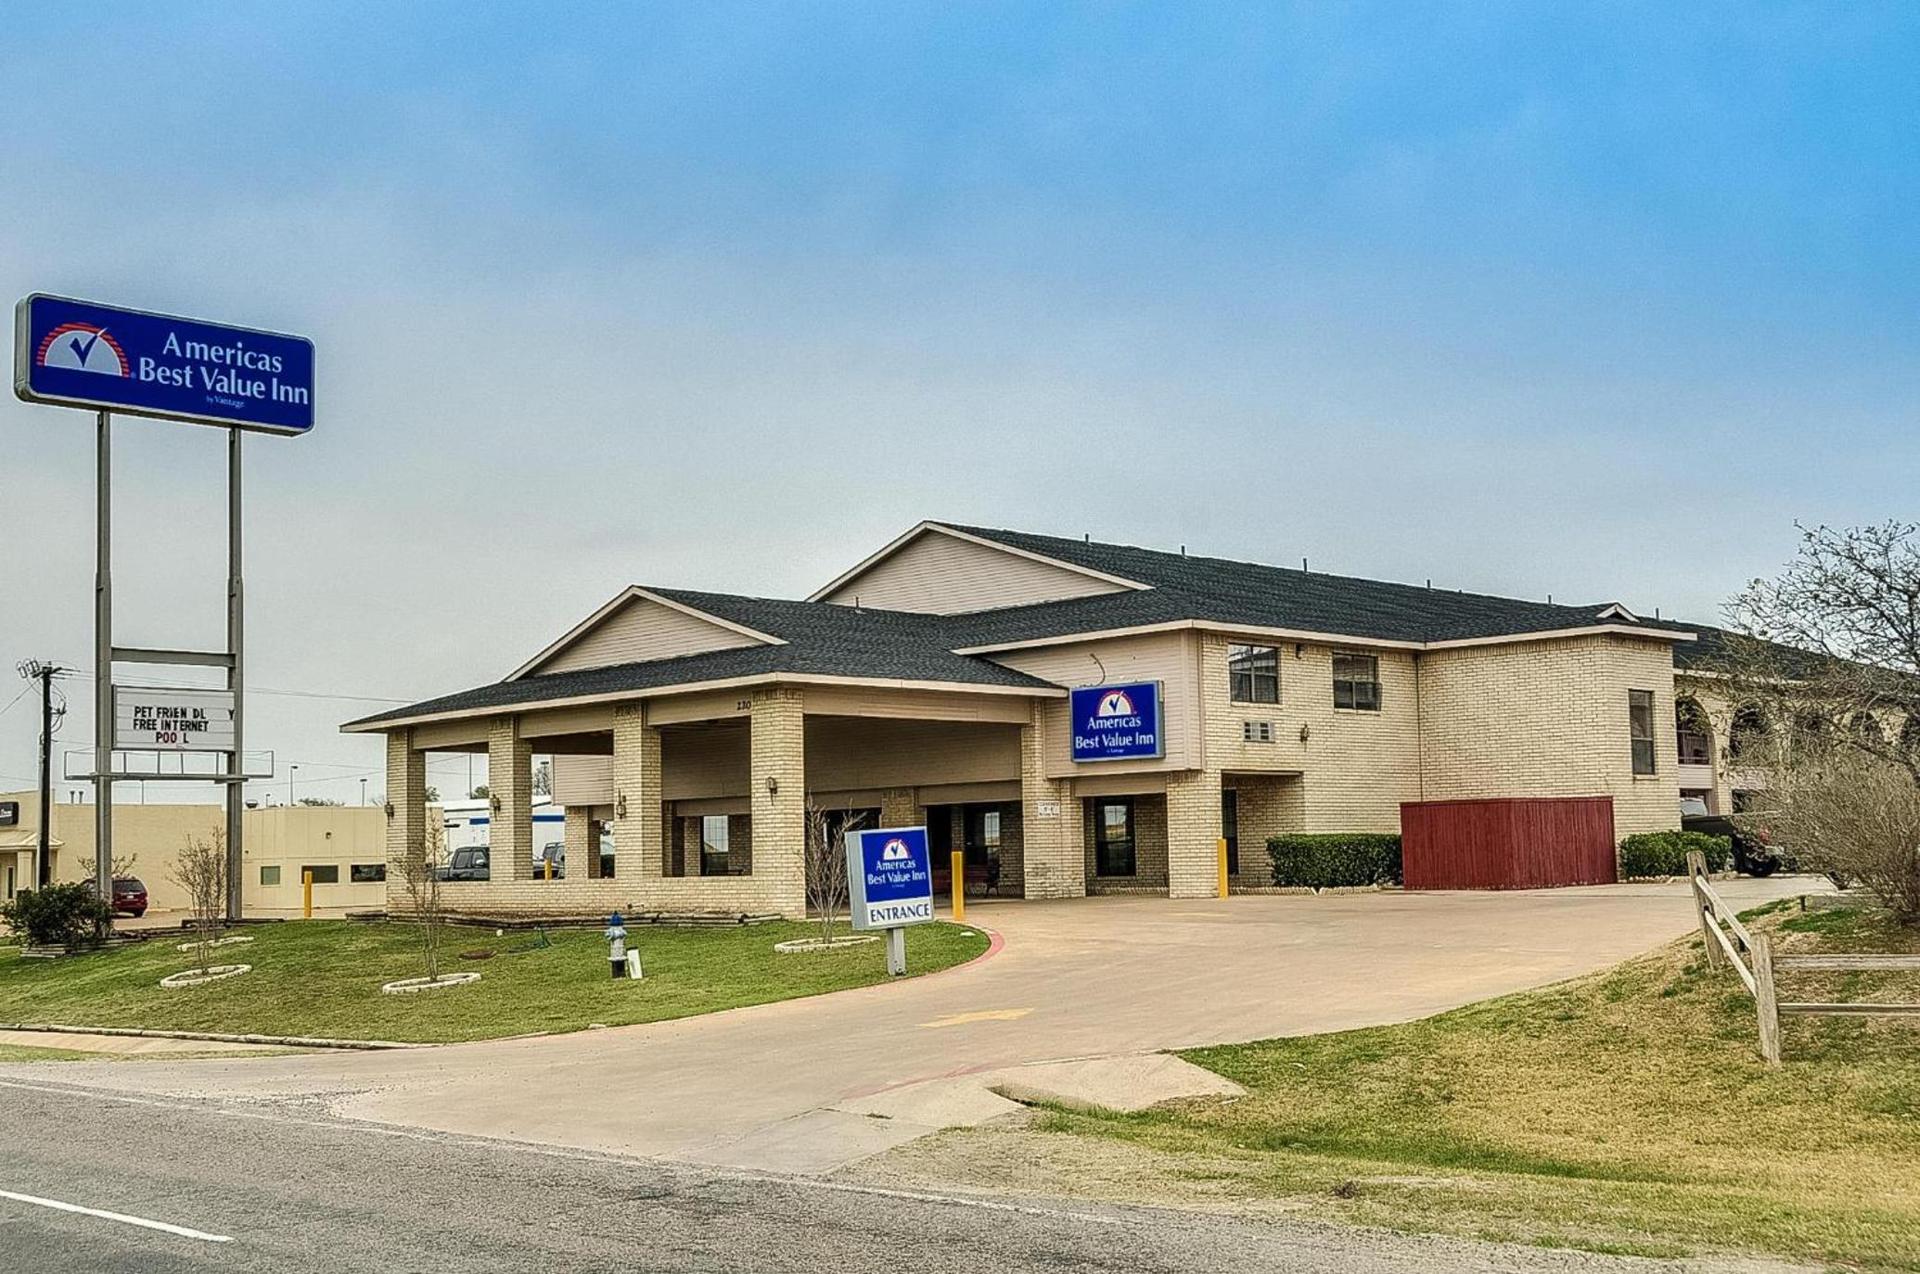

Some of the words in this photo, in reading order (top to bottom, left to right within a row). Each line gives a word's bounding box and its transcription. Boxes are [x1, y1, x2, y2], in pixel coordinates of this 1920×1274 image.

[162, 332, 283, 373] Americas
[139, 357, 194, 389] Best
[200, 366, 266, 400] Value
[272, 377, 309, 405] Inn
[134, 706, 153, 718] PET
[133, 719, 157, 730] FREE
[161, 720, 209, 732] INTERNET
[1088, 717, 1142, 730] Americas
[1075, 736, 1099, 749] Best
[1102, 732, 1132, 747] Value
[1135, 732, 1154, 745] Inn
[876, 860, 916, 871] Americas
[867, 874, 886, 885] Best
[887, 871, 911, 883] Value
[912, 870, 926, 880] Inn
[870, 903, 930, 922] ENTRANCE
